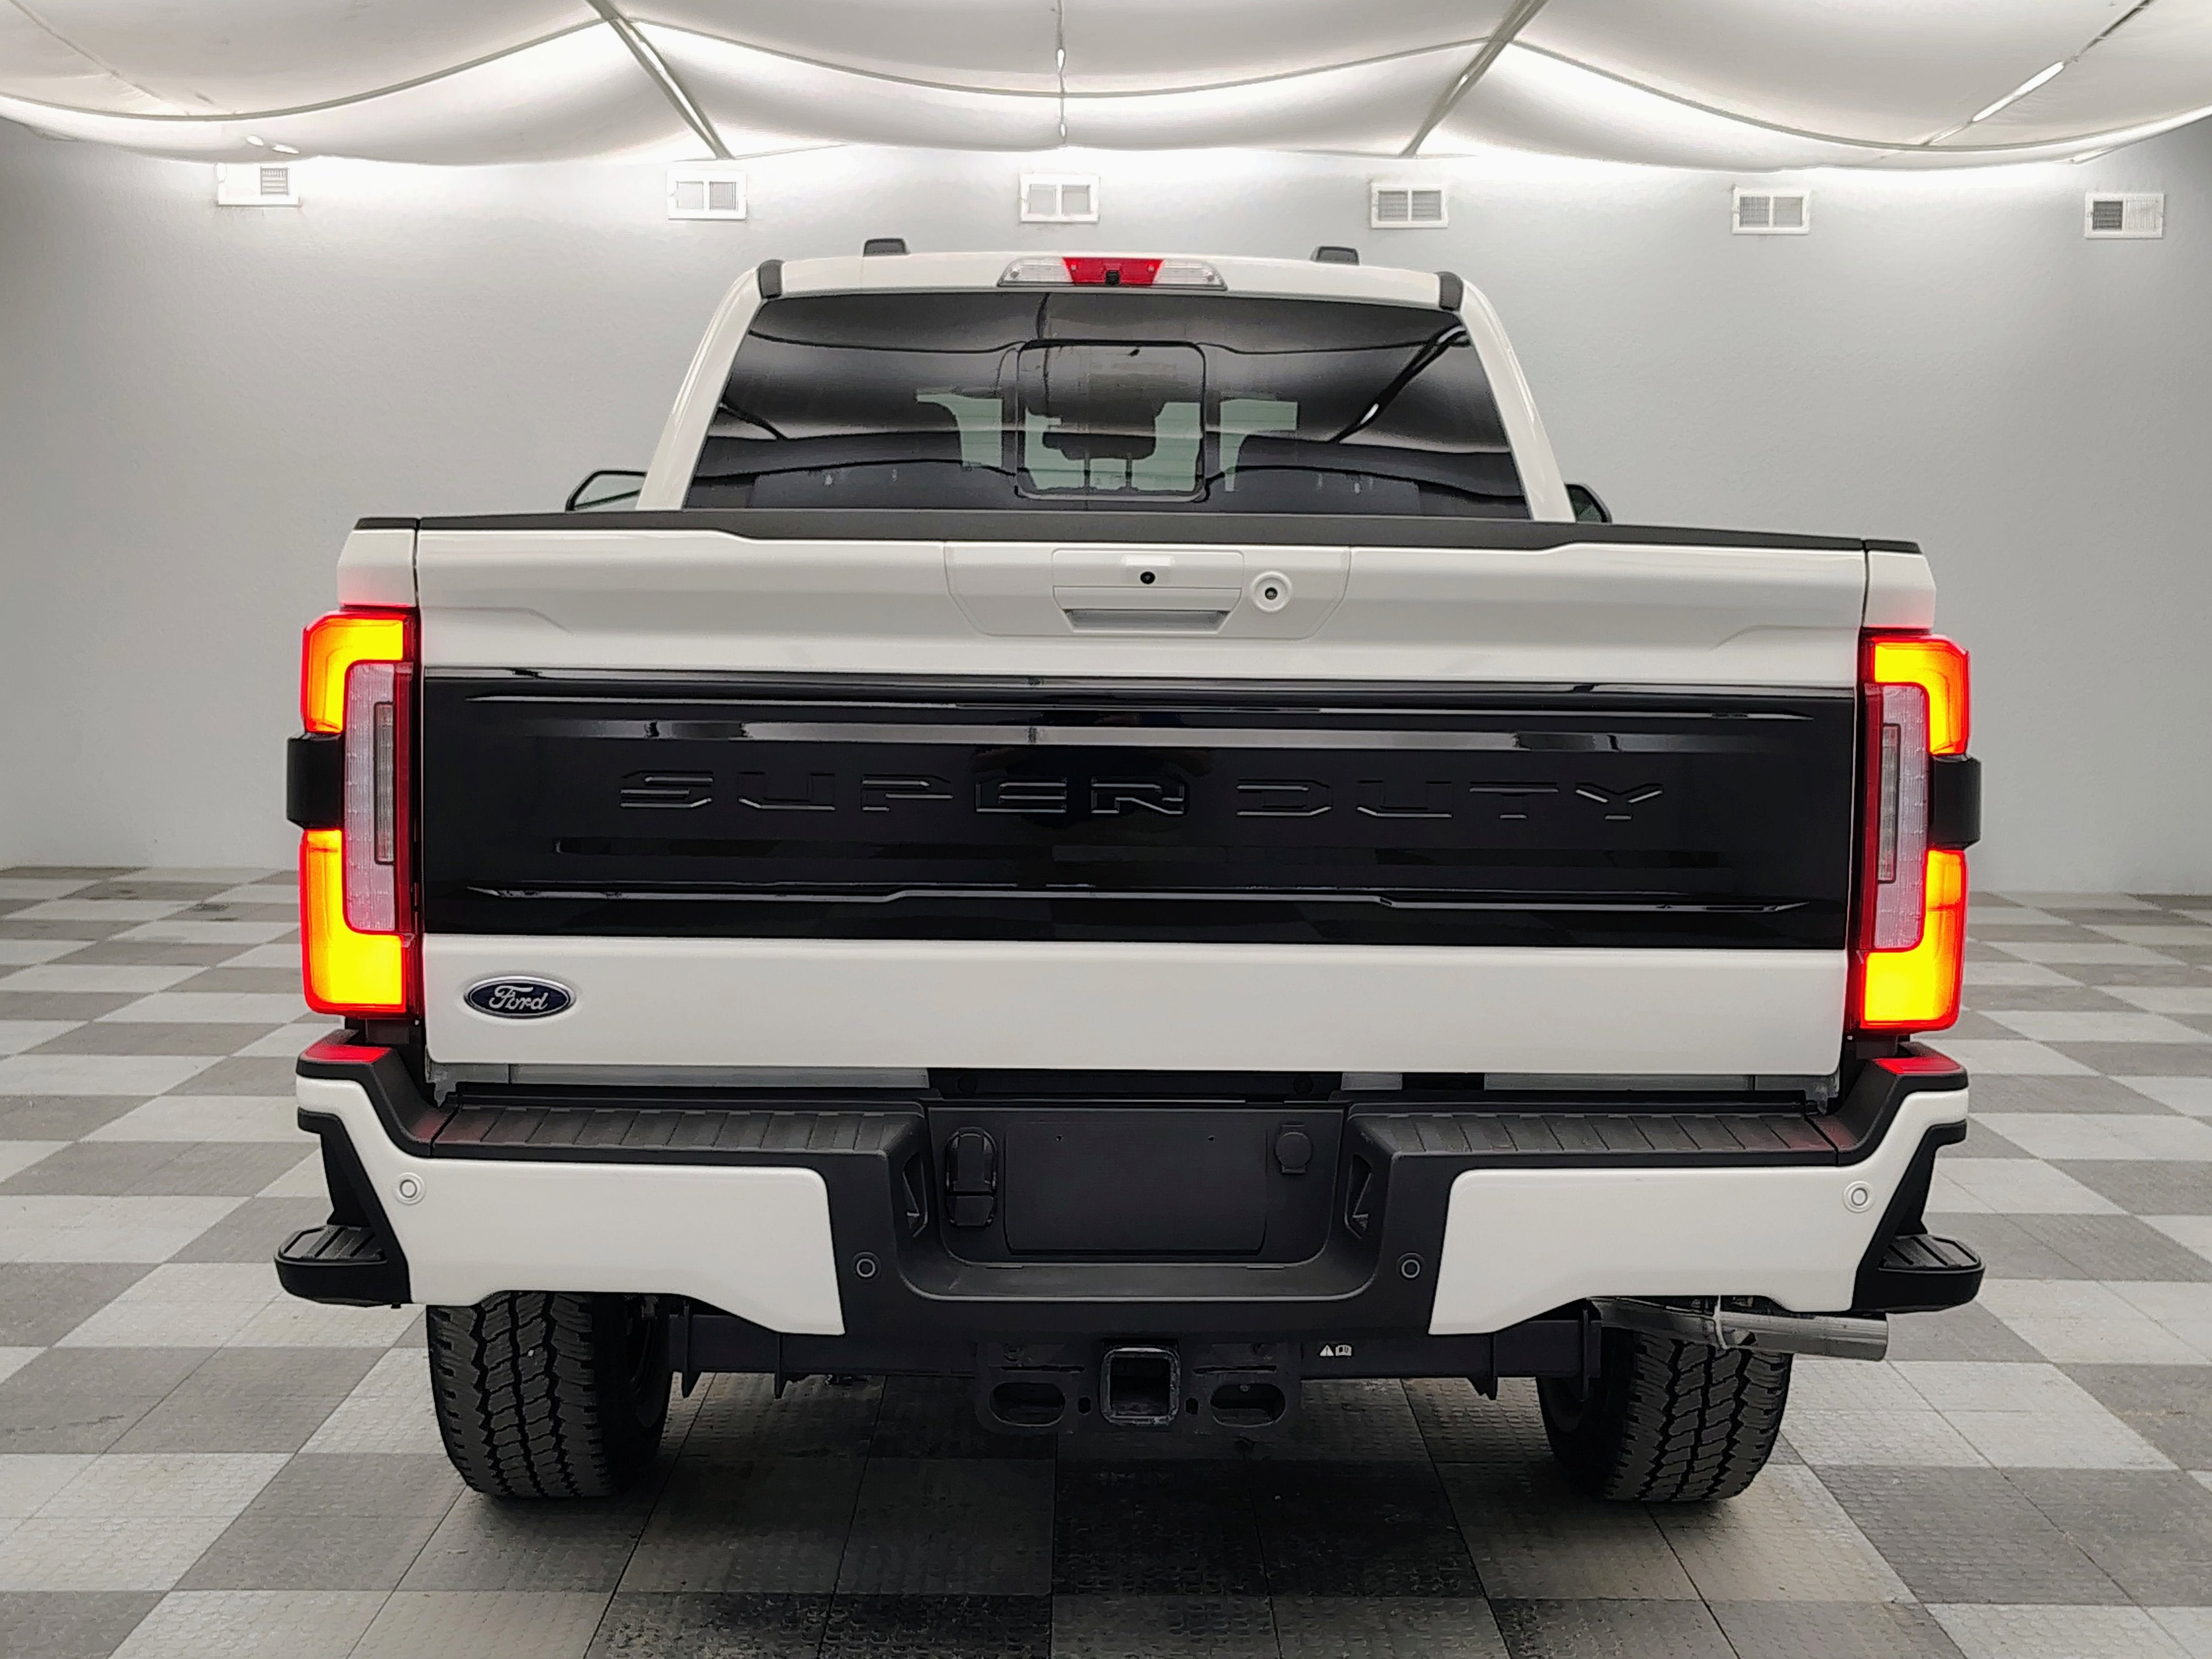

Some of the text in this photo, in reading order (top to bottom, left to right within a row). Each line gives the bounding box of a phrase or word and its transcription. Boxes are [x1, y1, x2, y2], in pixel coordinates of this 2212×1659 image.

[620, 770, 1664, 820] SUPER DUTY
[489, 985, 548, 1010] Ford
